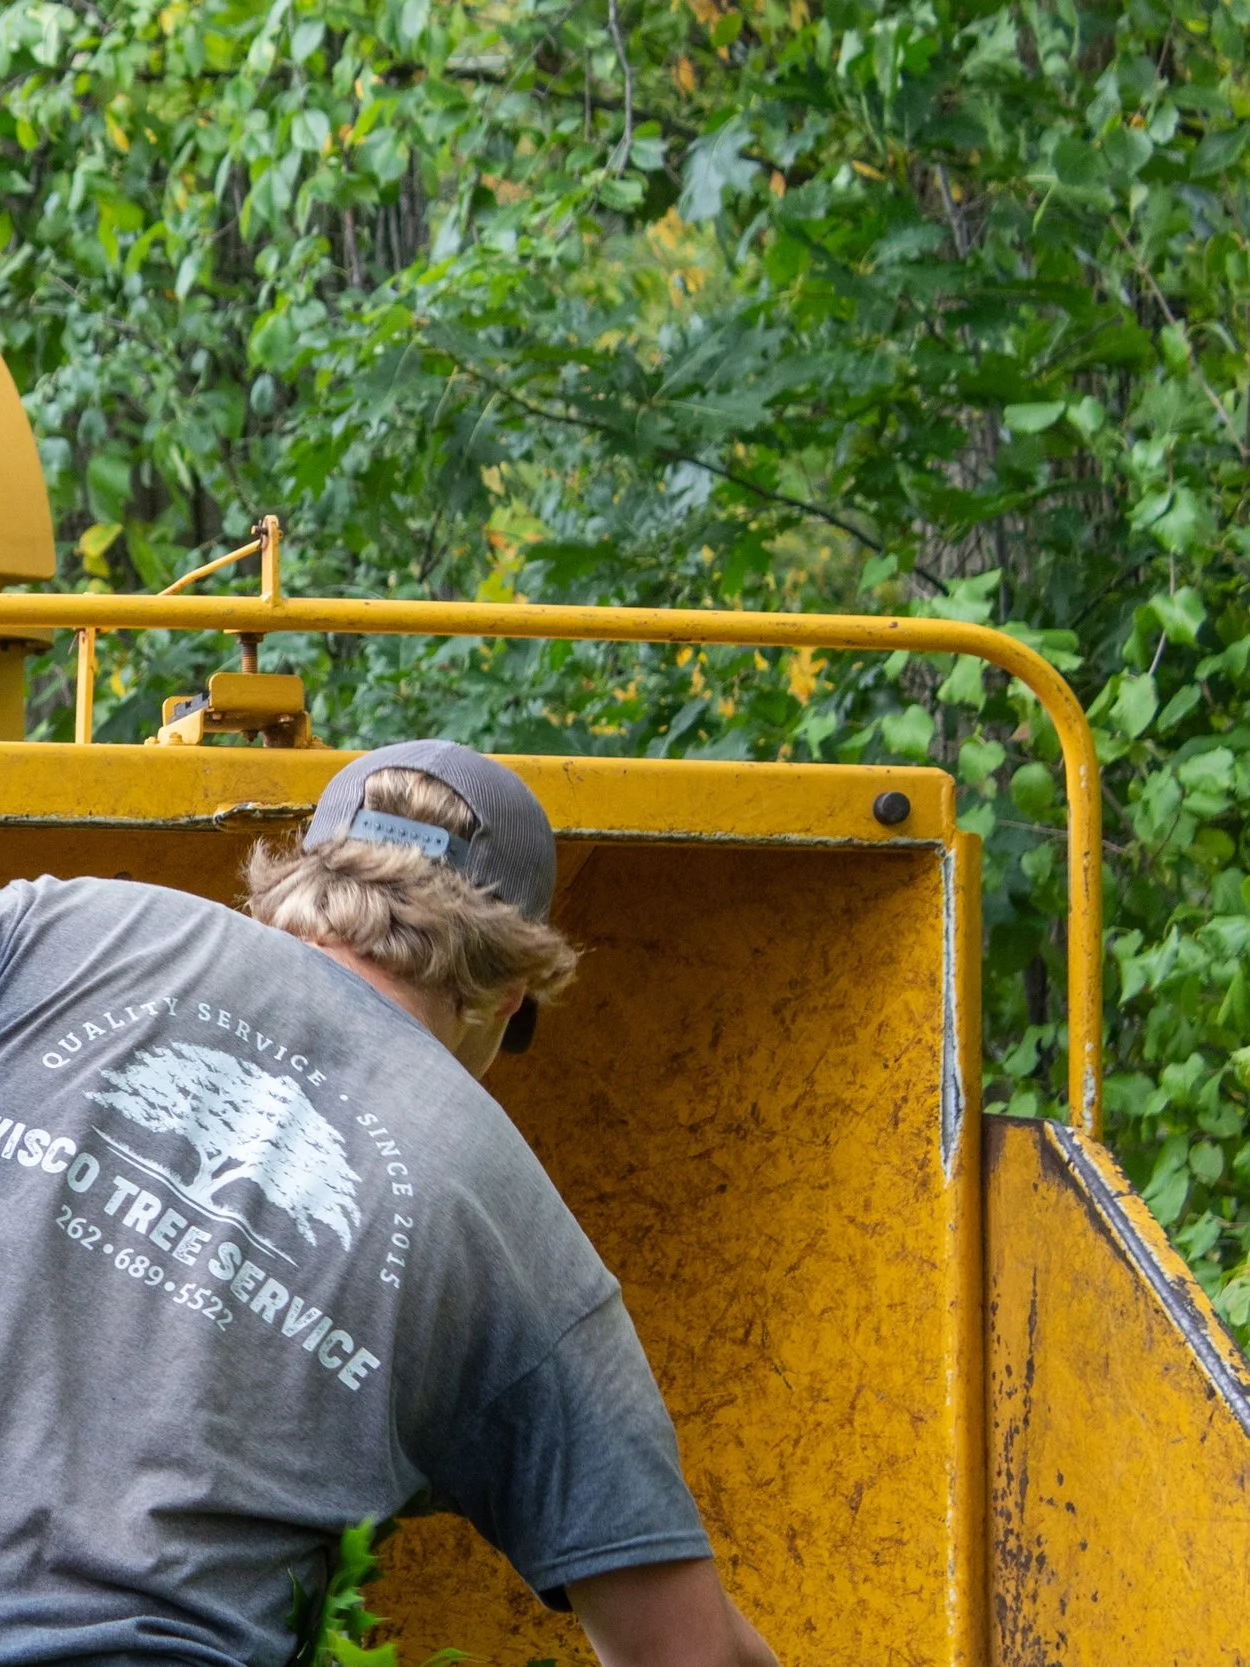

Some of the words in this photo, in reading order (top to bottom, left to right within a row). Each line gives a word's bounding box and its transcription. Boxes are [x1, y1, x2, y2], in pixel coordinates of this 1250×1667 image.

[42, 997, 178, 1069] QUALITY
[197, 1002, 327, 1087] SERVICE
[356, 1112, 414, 1197] SINCE
[103, 1175, 212, 1267] TREE
[208, 1241, 382, 1392] SERVICE
[379, 1213, 414, 1289] 2015
